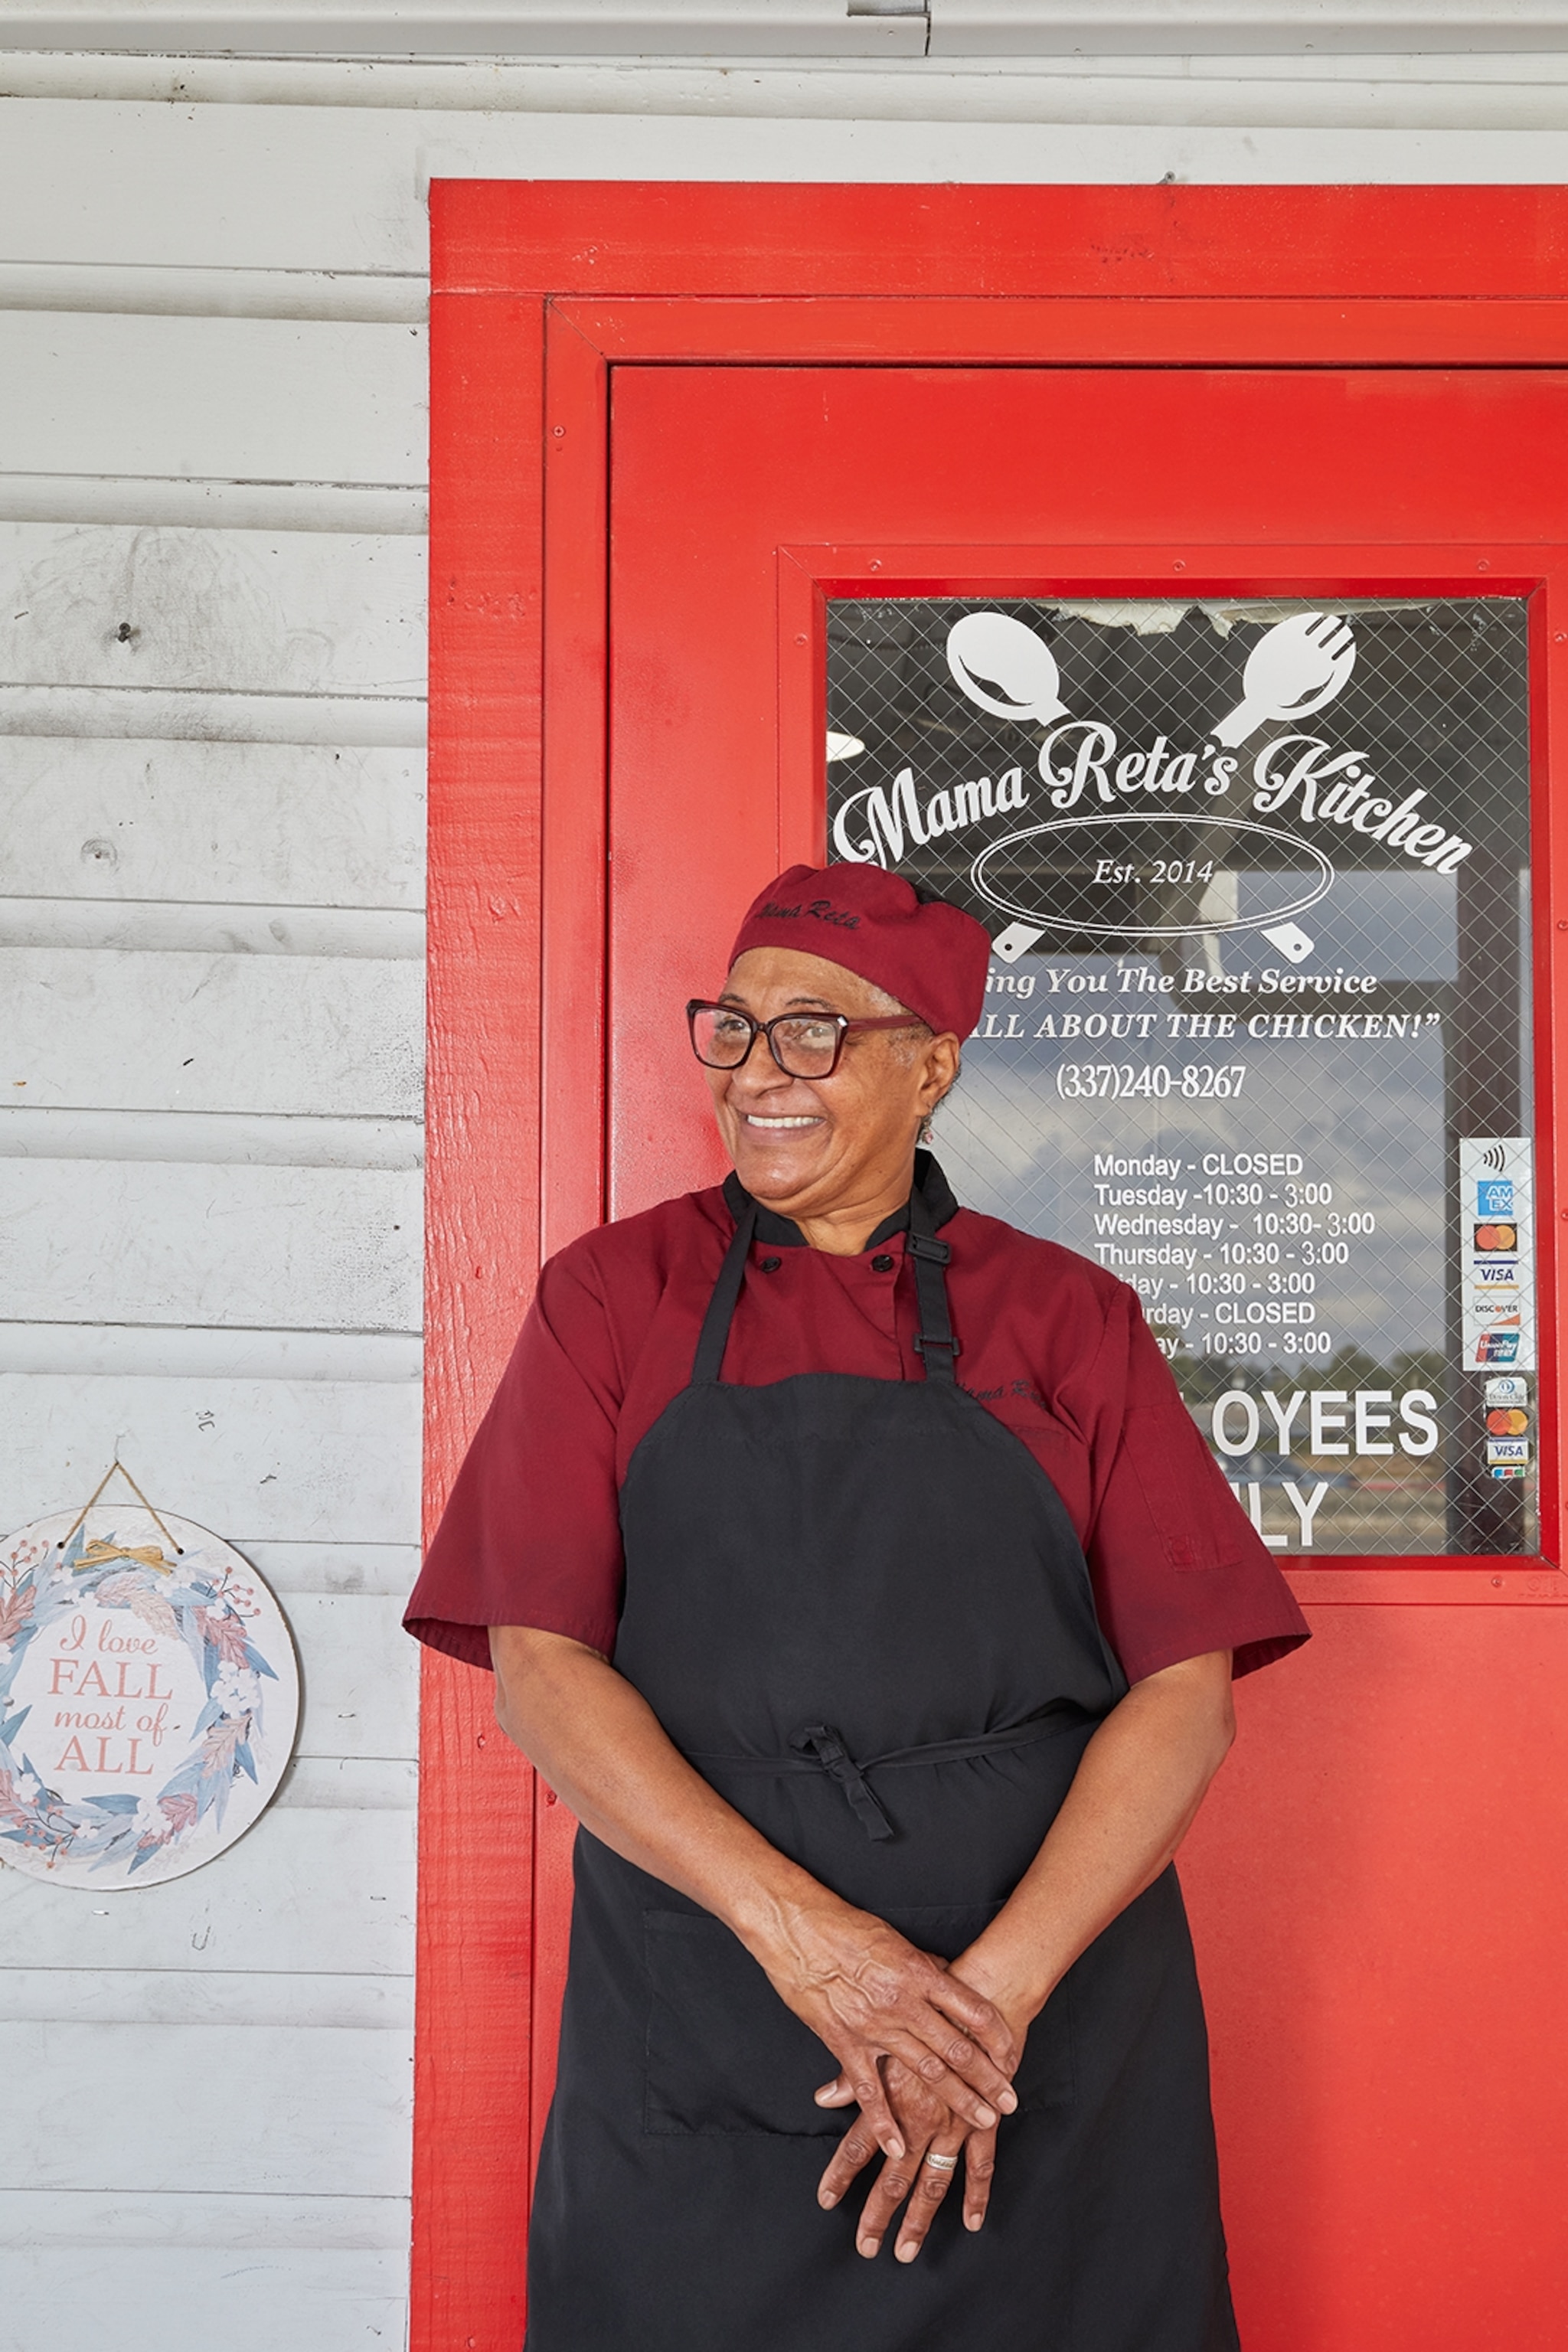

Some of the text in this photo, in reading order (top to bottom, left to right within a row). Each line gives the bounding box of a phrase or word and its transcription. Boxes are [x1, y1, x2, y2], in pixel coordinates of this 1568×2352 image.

[833, 720, 1473, 874] Mama Reta's Kitchen
[1093, 858, 1214, 884] Est. 2014
[805, 900, 860, 930] Reta
[985, 967, 1377, 1000] ing You The Best Service
[1033, 1013, 1154, 1039] ABOUT
[1167, 1013, 1237, 1038] THE
[1057, 1064, 1246, 1099] (337)240-8267
[1094, 1154, 1181, 1181] Monday
[1203, 1154, 1303, 1176] CLOSED
[1095, 1184, 1187, 1210] Tuesday
[1284, 1183, 1332, 1207] 3:00
[1487, 1186, 1513, 1199] AM
[1489, 1198, 1513, 1211] EX
[1094, 1214, 1223, 1240] Wednesday
[1328, 1212, 1375, 1237] 3:00
[1094, 1243, 1197, 1269] Thursday
[1220, 1243, 1279, 1266] 10:30
[1302, 1241, 1349, 1266] 3:00
[1119, 1273, 1163, 1300] day
[1187, 1272, 1246, 1295] 10:30
[1267, 1272, 1315, 1295] 3:00
[1481, 1269, 1514, 1281] VISA
[1142, 1303, 1194, 1329] rday
[1215, 1302, 1315, 1324] CLOSED
[1475, 1305, 1518, 1313] DISCOVER
[1201, 1332, 1262, 1354] 10:30
[1283, 1332, 1331, 1354] 3:00
[1212, 1389, 1439, 1456] OYEES
[1494, 1446, 1524, 1456] VISA
[1228, 1481, 1329, 1547] LY
[60, 1615, 158, 1655] I love
[47, 1658, 173, 1700] FALL
[54, 1704, 169, 1746] most of
[54, 1736, 155, 1775] ALL
